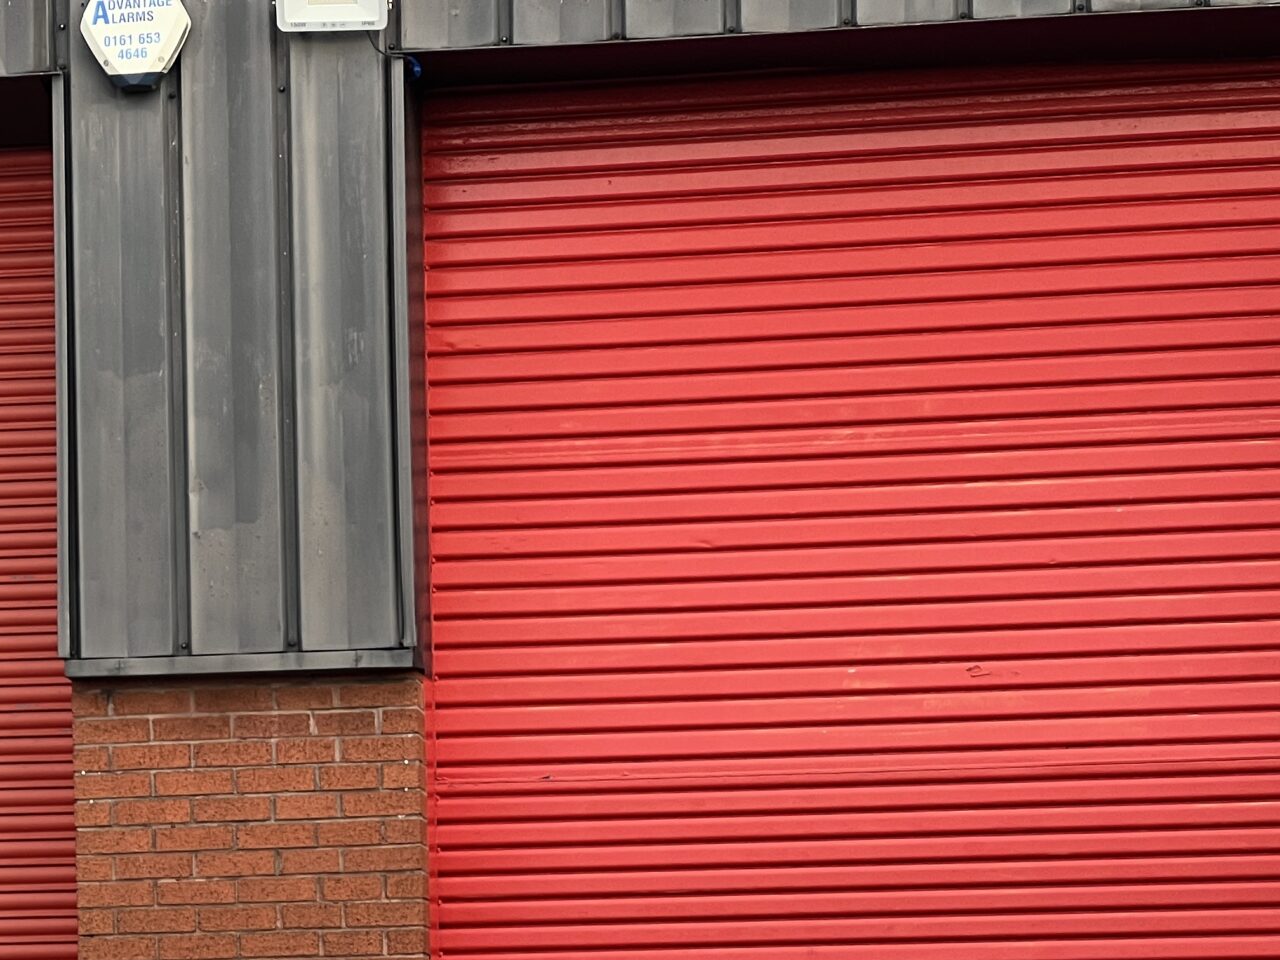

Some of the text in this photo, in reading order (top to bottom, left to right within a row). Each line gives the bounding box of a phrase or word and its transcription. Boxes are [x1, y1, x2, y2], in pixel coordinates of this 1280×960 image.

[104, 32, 161, 47] 0161 653
[117, 47, 148, 60] 4646
